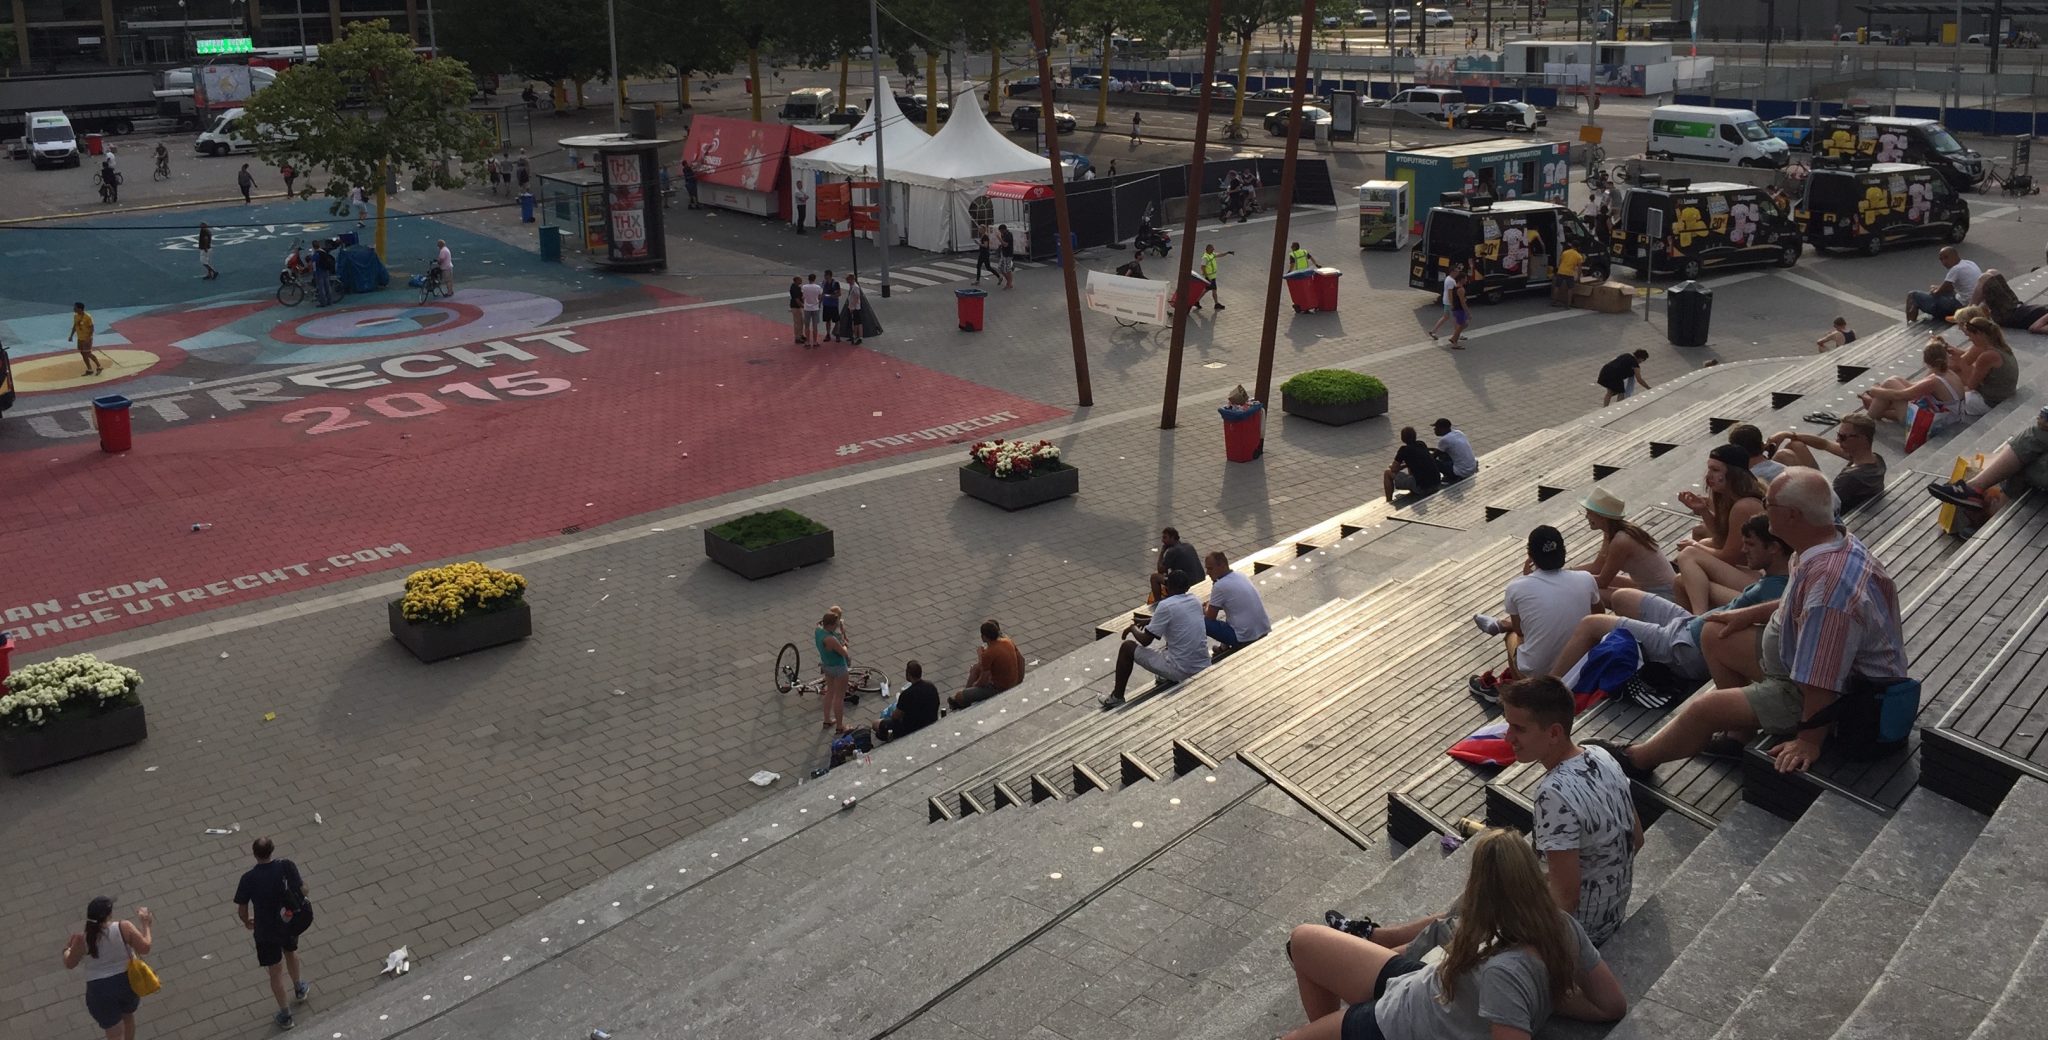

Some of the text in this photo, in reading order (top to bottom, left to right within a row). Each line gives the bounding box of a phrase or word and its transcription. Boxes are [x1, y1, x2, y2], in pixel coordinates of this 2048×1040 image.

[609, 158, 636, 172] THX
[612, 171, 638, 183] YOU
[613, 215, 641, 228] THX
[616, 227, 643, 239] YOU
[28, 330, 592, 439] UTRECHT
[281, 370, 573, 435] 2015
